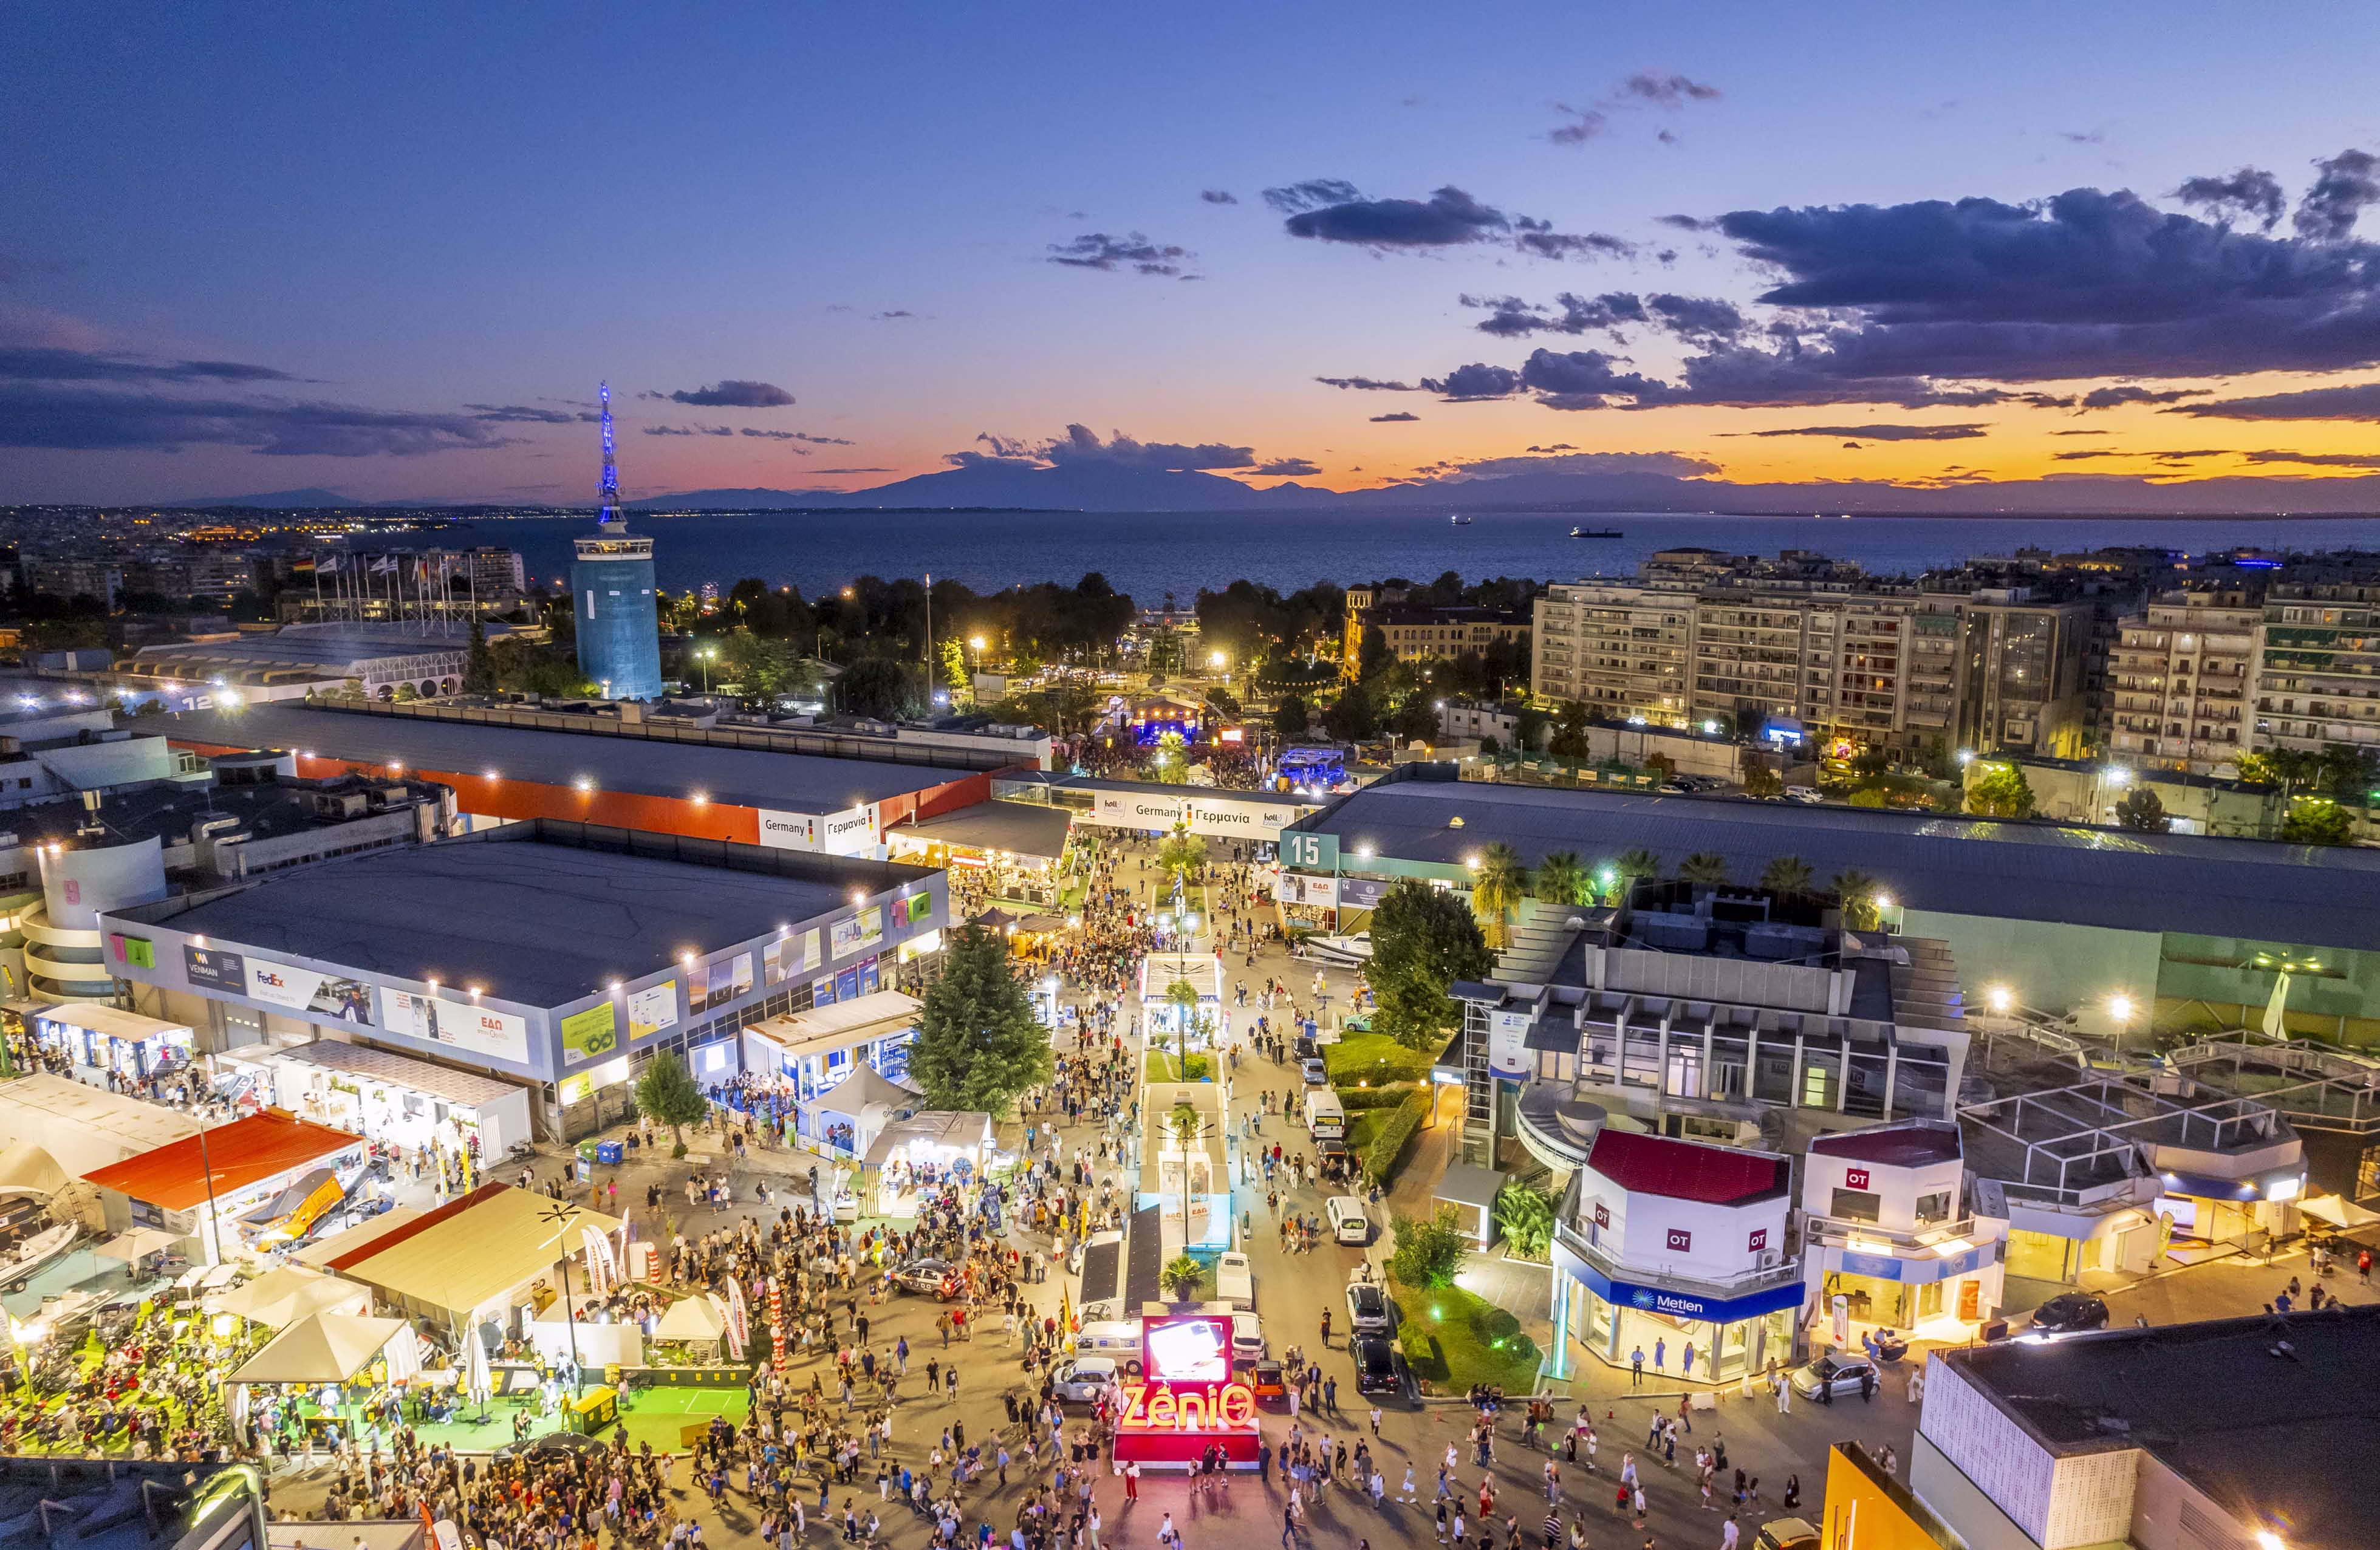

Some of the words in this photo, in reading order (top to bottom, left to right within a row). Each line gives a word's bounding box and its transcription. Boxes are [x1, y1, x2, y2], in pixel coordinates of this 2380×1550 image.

[182, 695, 213, 711] 12
[1135, 804, 1182, 821] Germany
[1195, 809, 1250, 824] Γερμανία
[765, 819, 805, 836] Germany
[827, 816, 866, 835] Γερμανία
[1291, 835, 1319, 865] 15
[63, 878, 81, 906] 9
[1312, 882, 1329, 890] ΕΔΩ
[188, 963, 219, 977] VENMAN
[256, 970, 285, 988] FedEx
[480, 1016, 503, 1031] ΕΔΩ
[1848, 1173, 1867, 1185] OT
[1596, 1209, 1609, 1223] OT
[1669, 1235, 1688, 1246] OT
[1751, 1235, 1765, 1246] OT
[909, 1280, 931, 1289] YUDO
[1657, 1295, 1703, 1313] Metlen
